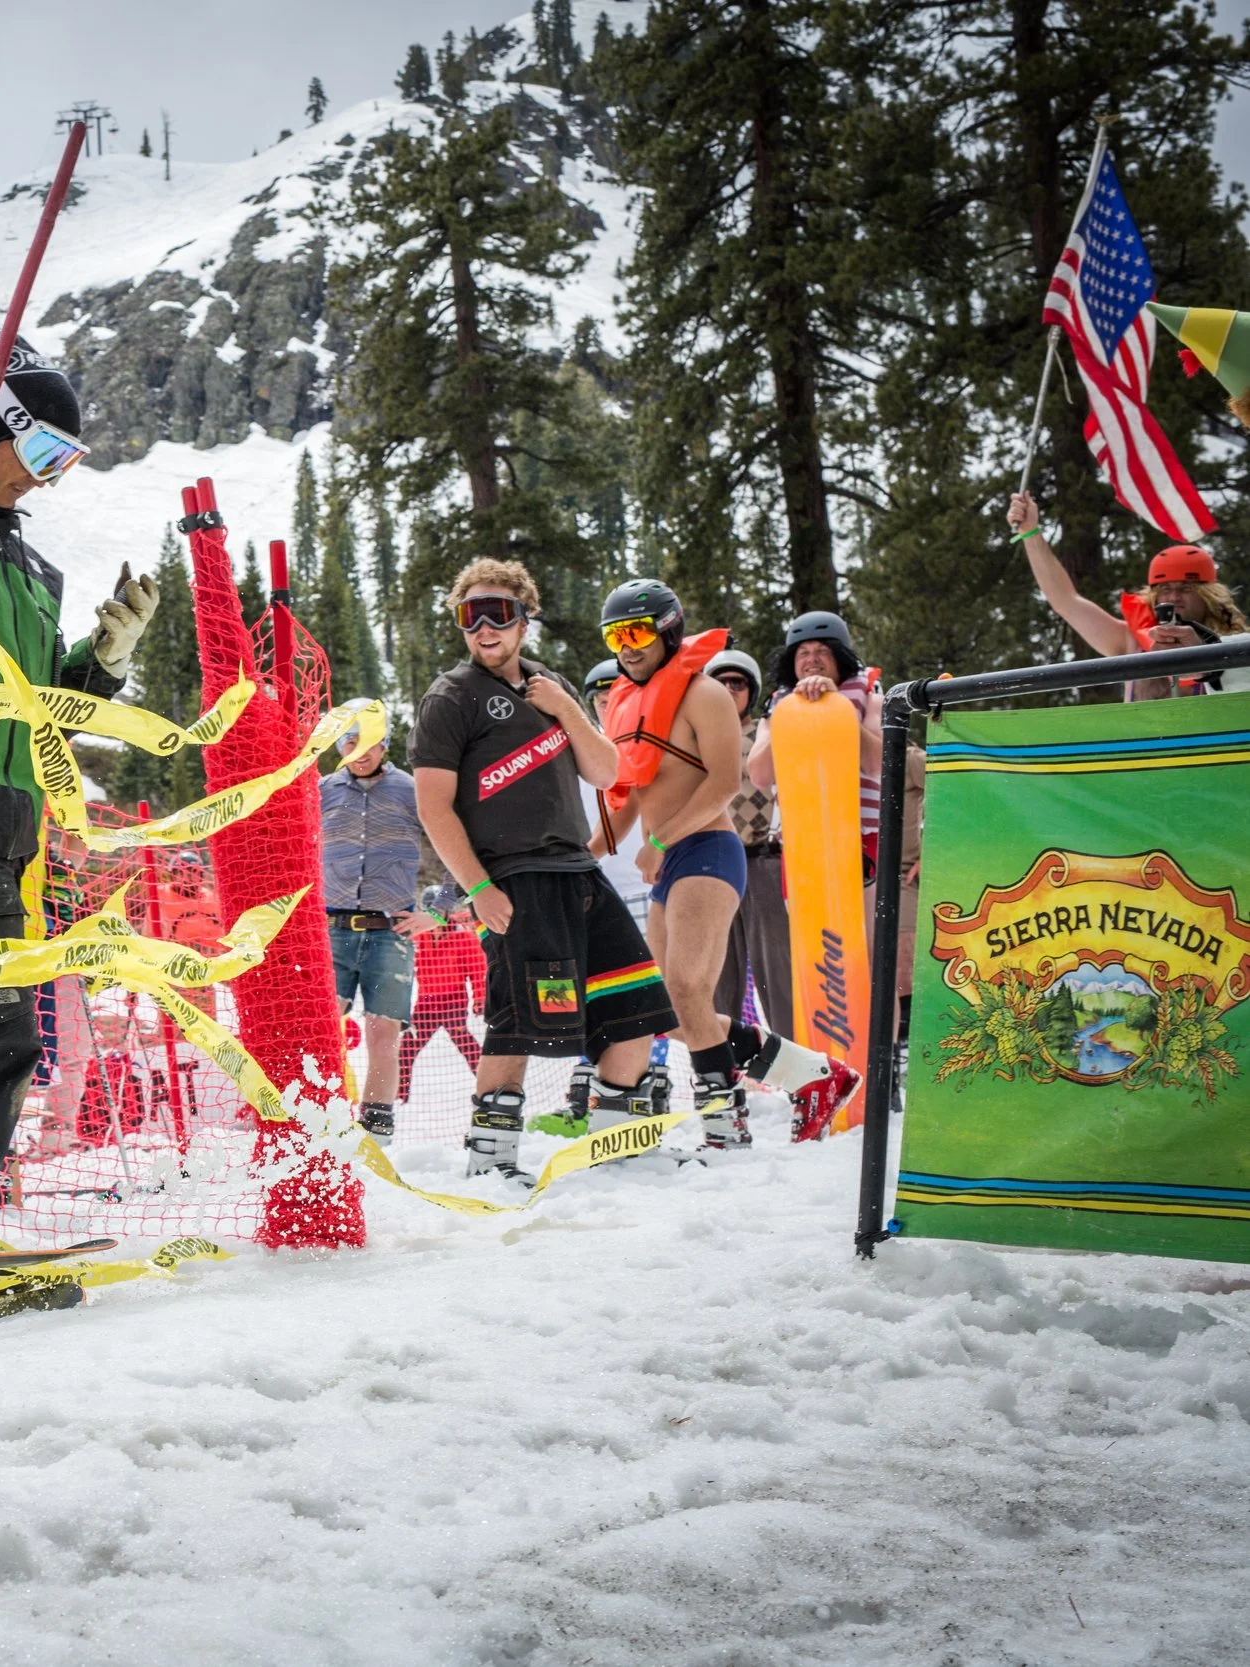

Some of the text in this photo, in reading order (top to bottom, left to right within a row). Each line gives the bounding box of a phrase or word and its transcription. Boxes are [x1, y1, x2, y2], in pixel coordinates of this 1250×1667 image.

[36, 691, 98, 725] CAUTI
[481, 730, 567, 790] SQUAW VALLE
[986, 900, 1225, 965] SIERRA NEVADA
[812, 928, 855, 1051] Burton
[590, 1122, 664, 1161] CAUTION
